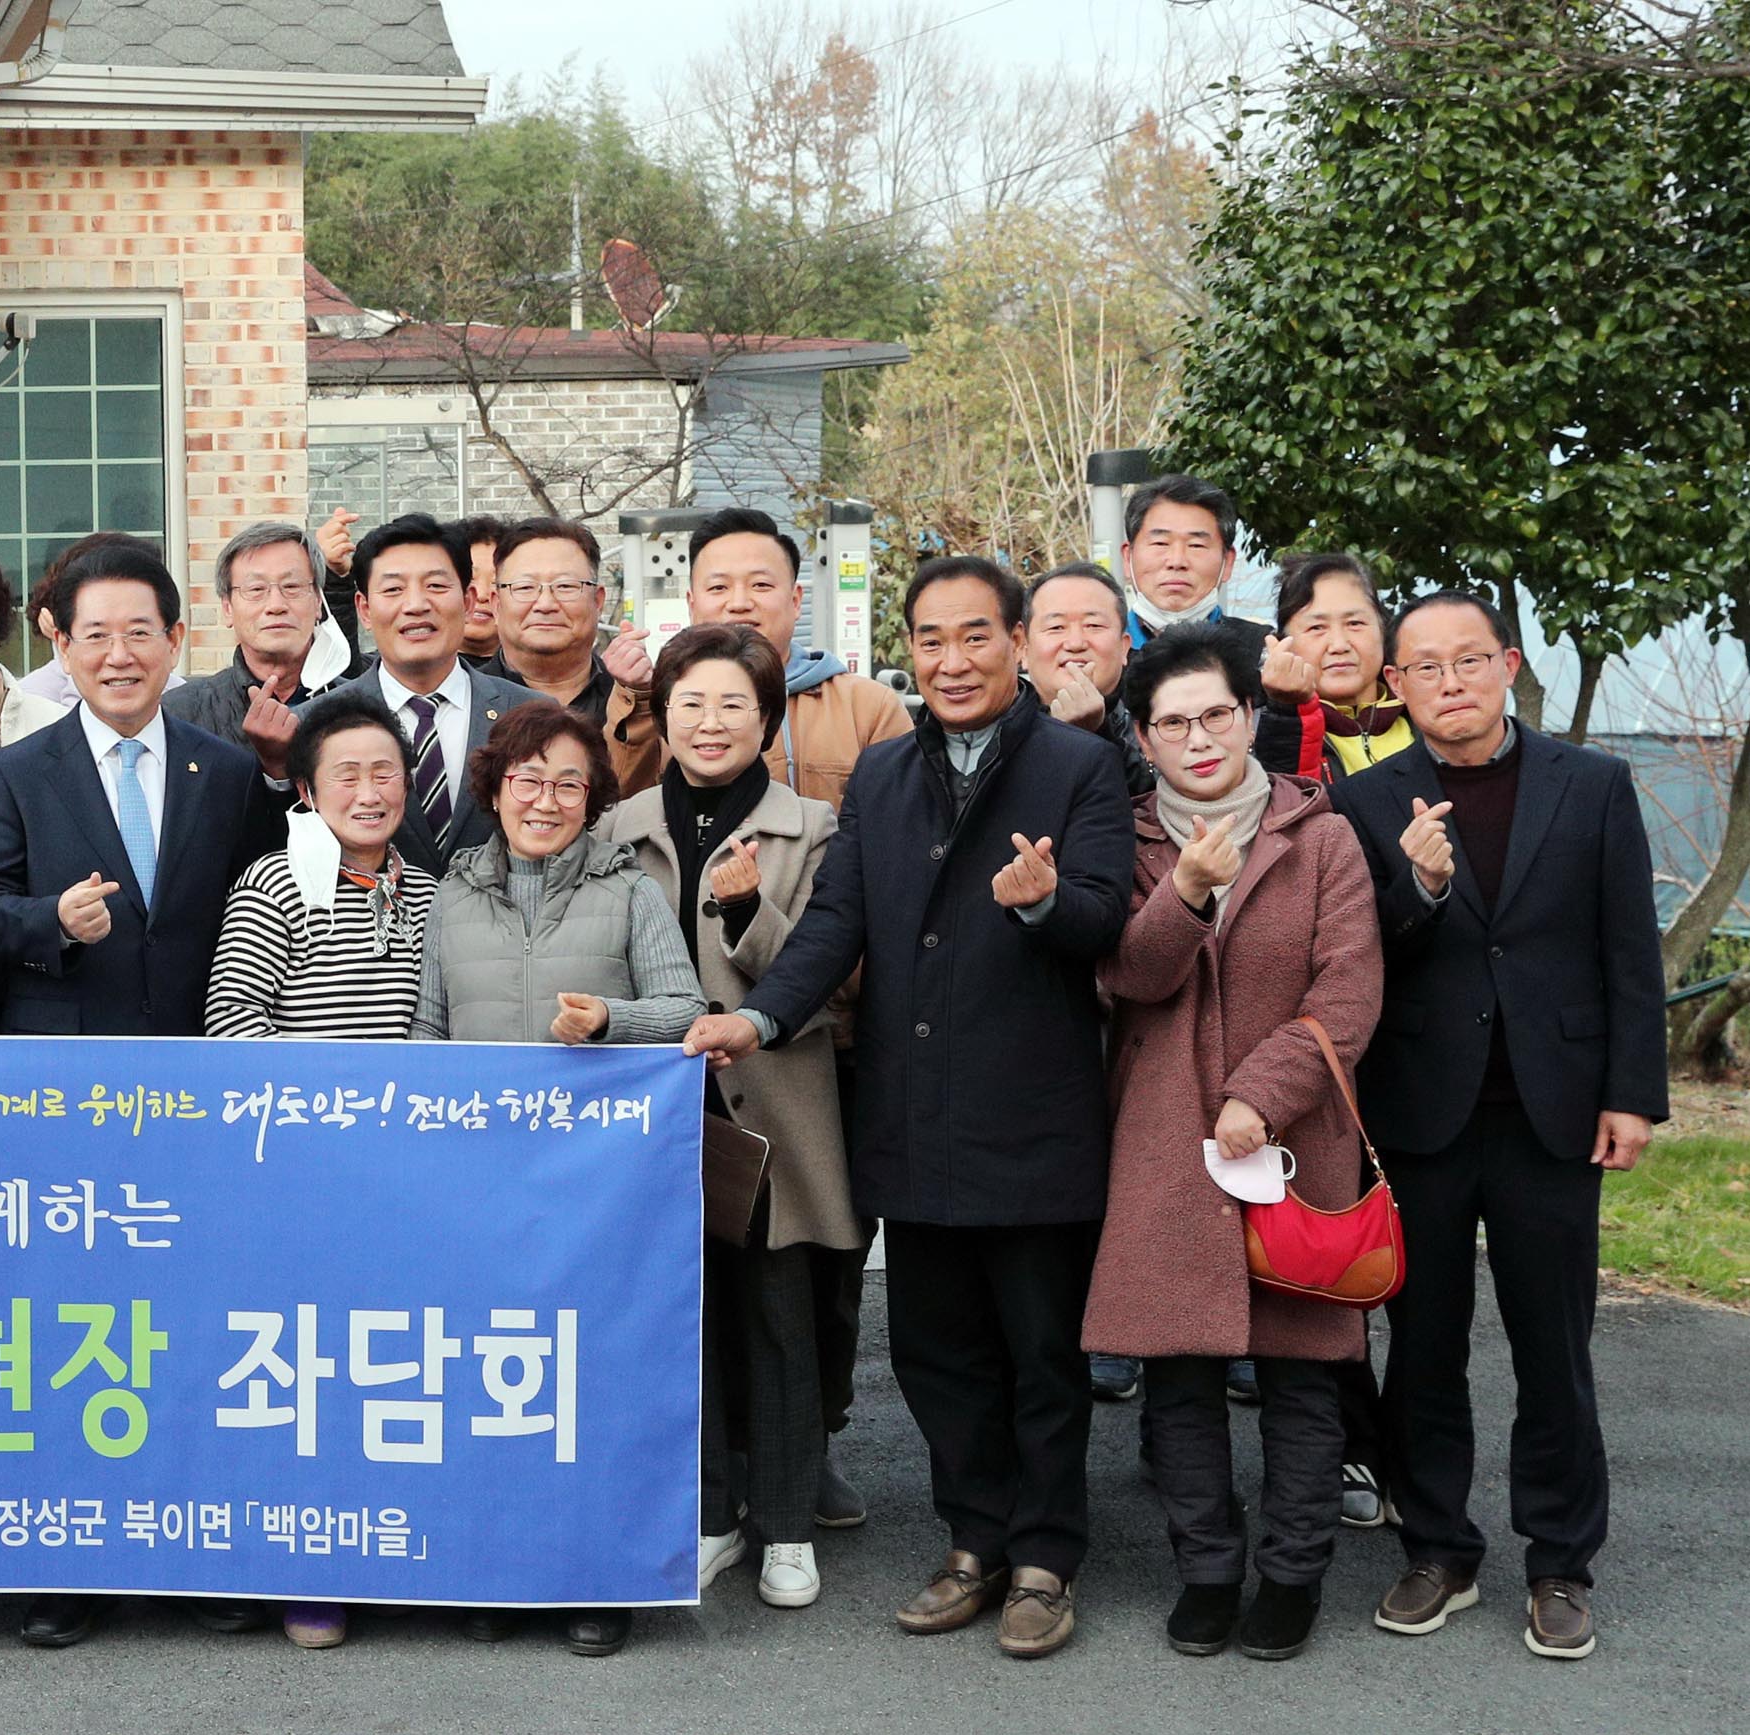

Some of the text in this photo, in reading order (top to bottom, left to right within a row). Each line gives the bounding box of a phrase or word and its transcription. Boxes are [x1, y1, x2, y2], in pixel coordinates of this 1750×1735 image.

[77, 1083, 208, 1137] 웅비하는
[221, 1080, 397, 1164] 대도약!
[406, 1090, 491, 1132] 전남
[215, 1303, 578, 1464] 좌담회
[122, 1499, 232, 1551] 북이면
